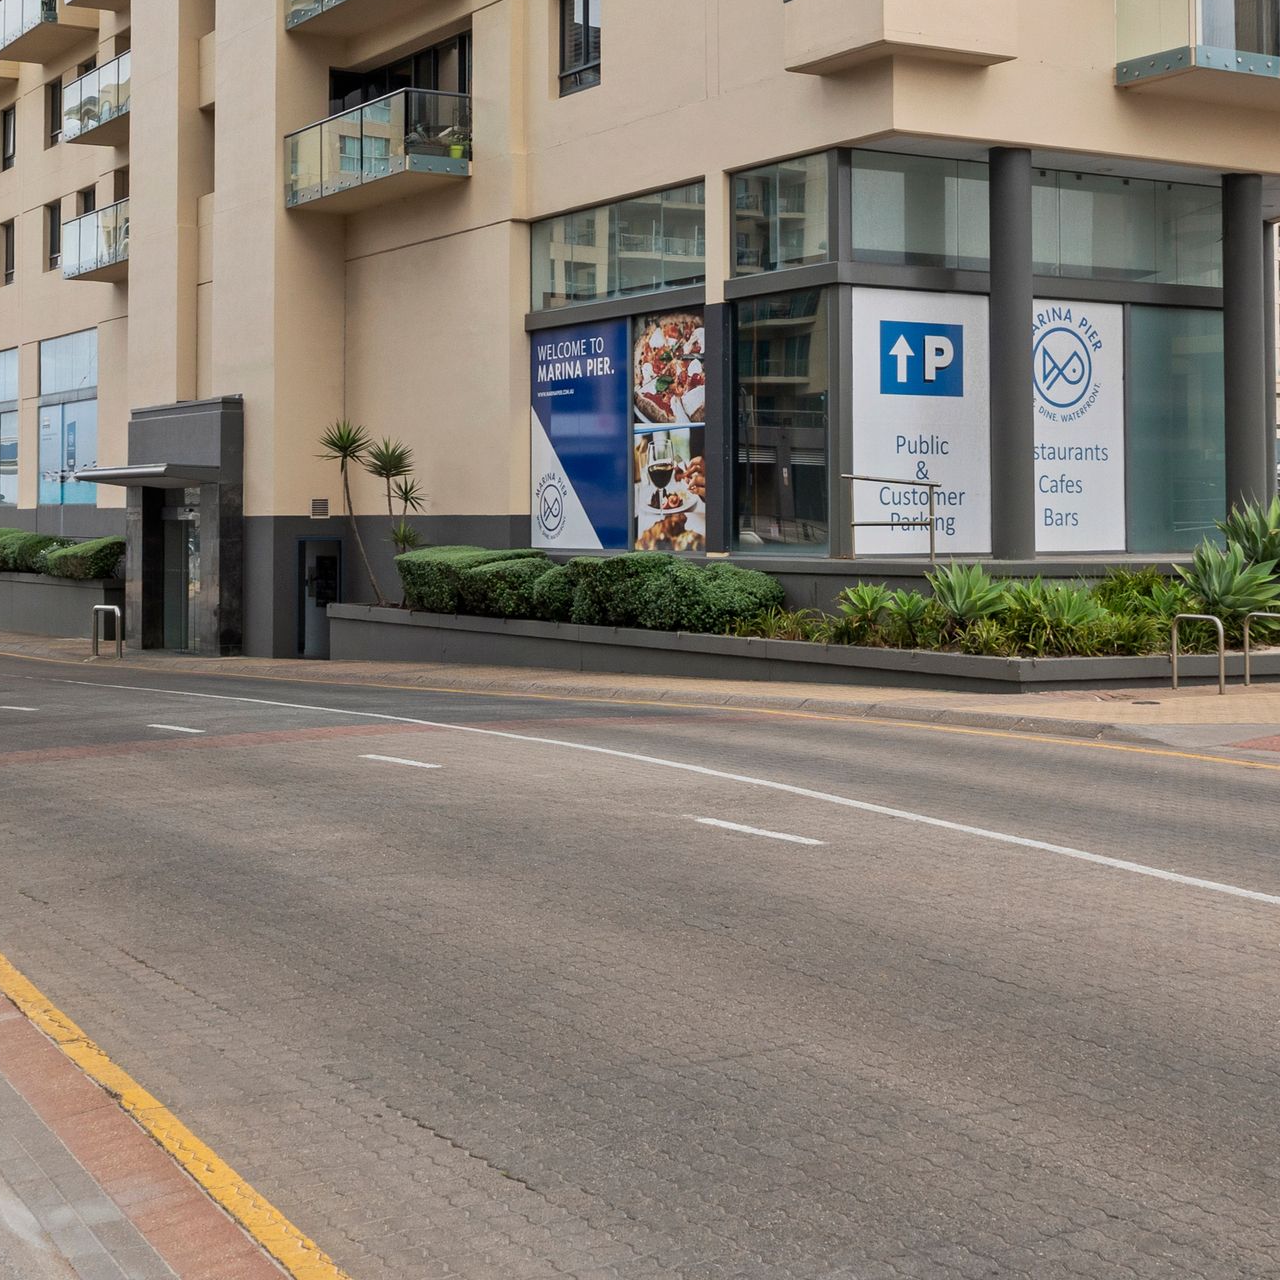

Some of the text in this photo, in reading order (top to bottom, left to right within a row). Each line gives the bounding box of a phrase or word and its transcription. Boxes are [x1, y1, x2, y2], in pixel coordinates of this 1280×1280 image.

[1032, 307, 1102, 352] ARINA PIER
[537, 337, 604, 361] WELCOME TO
[924, 335, 954, 382] P
[537, 357, 615, 382] MARINA PIER.
[896, 435, 949, 455] Public
[1033, 443, 1109, 461] staurants
[916, 461, 929, 480] &
[1039, 474, 1083, 493] Cafes
[879, 486, 965, 506] Customer
[891, 512, 956, 536] Parkng
[1044, 508, 1079, 527] Bars
